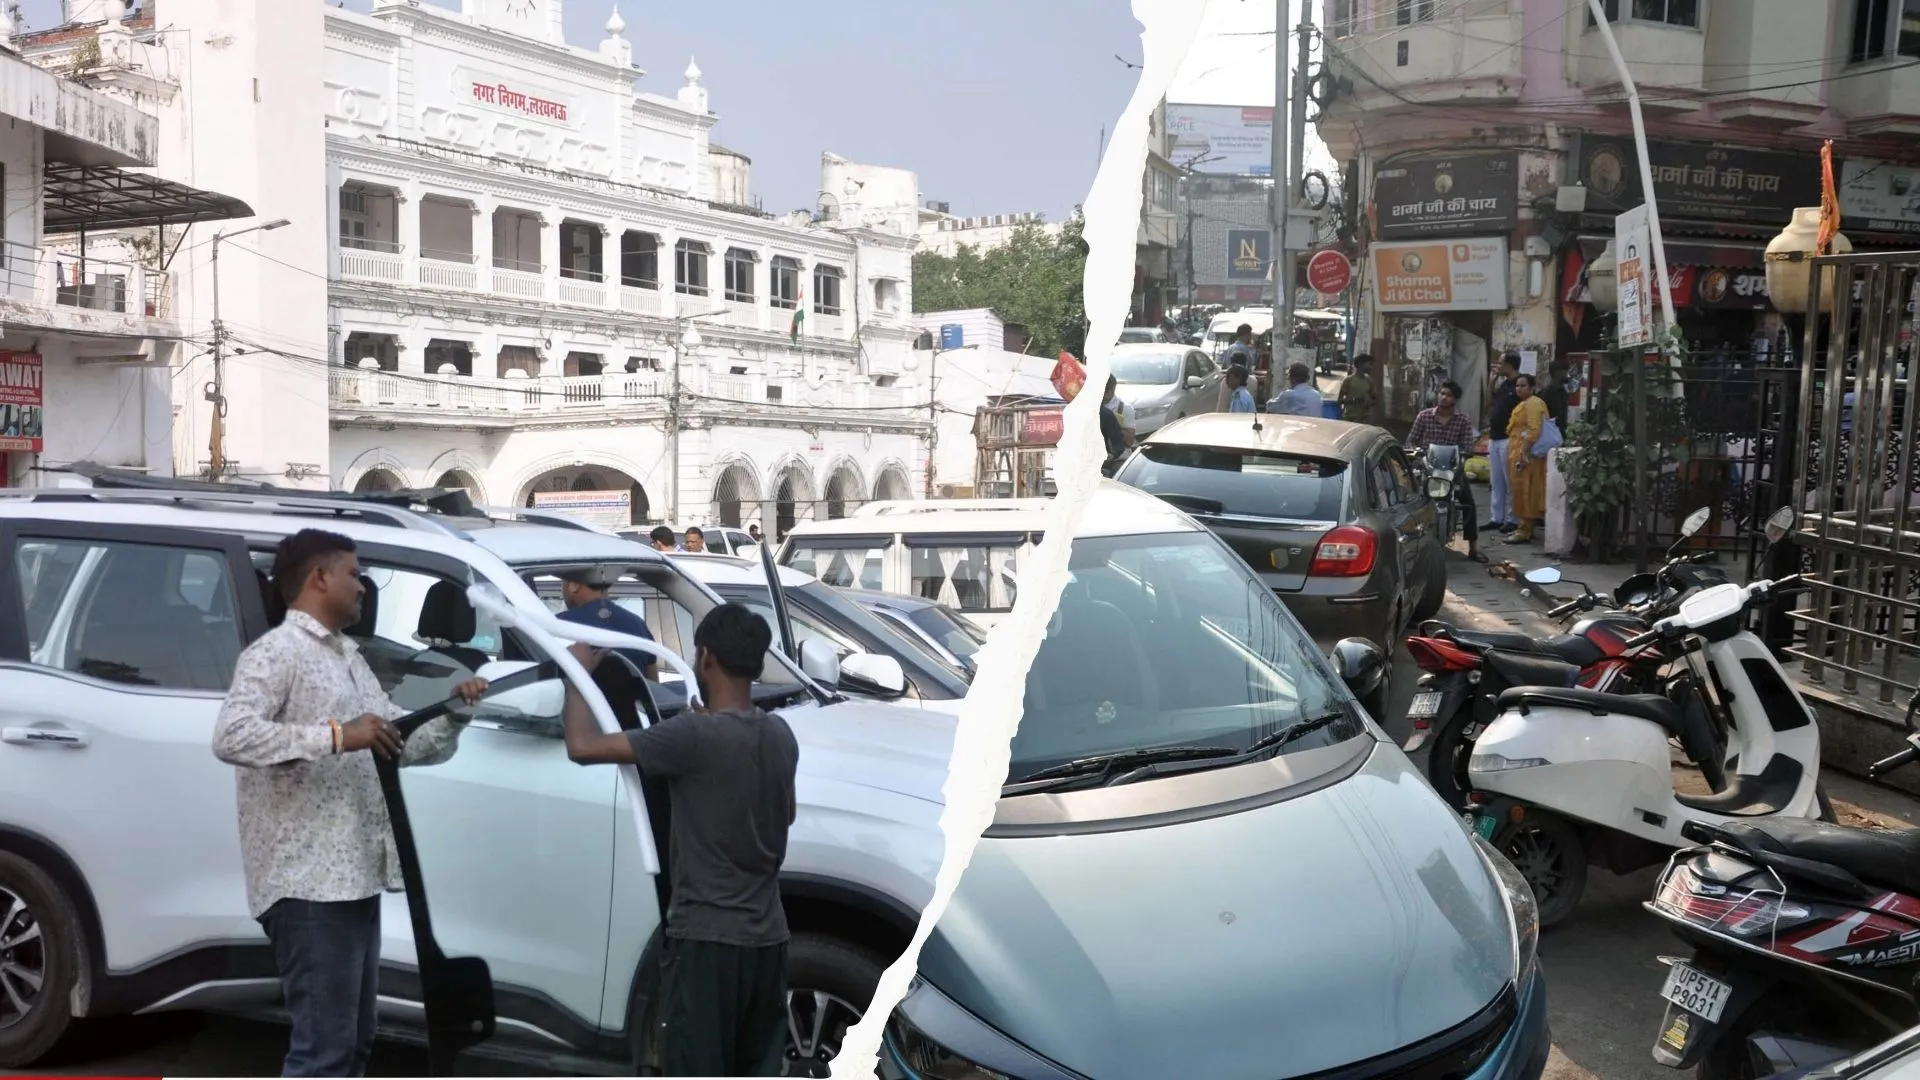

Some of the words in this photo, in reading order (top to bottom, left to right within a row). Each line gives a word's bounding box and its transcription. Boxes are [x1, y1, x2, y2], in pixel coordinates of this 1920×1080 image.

[472, 82, 495, 103] नगर
[1692, 164, 1716, 187] जी
[1720, 167, 1743, 190] की
[1747, 173, 1781, 192] चाय
[1392, 201, 1424, 216] शर्मा
[1425, 199, 1443, 213] जी
[1447, 198, 1466, 212] की
[1469, 198, 1497, 210] चाय
[1240, 238, 1256, 258] N
[1386, 275, 1441, 287] Sharma
[1384, 290, 1396, 302] Ji
[1398, 289, 1411, 300] Ki
[1414, 287, 1447, 300] Chai
[1850, 941, 1920, 966] MAEST
[1678, 967, 1722, 1001] UP51A
[1670, 985, 1714, 1018] P9031
